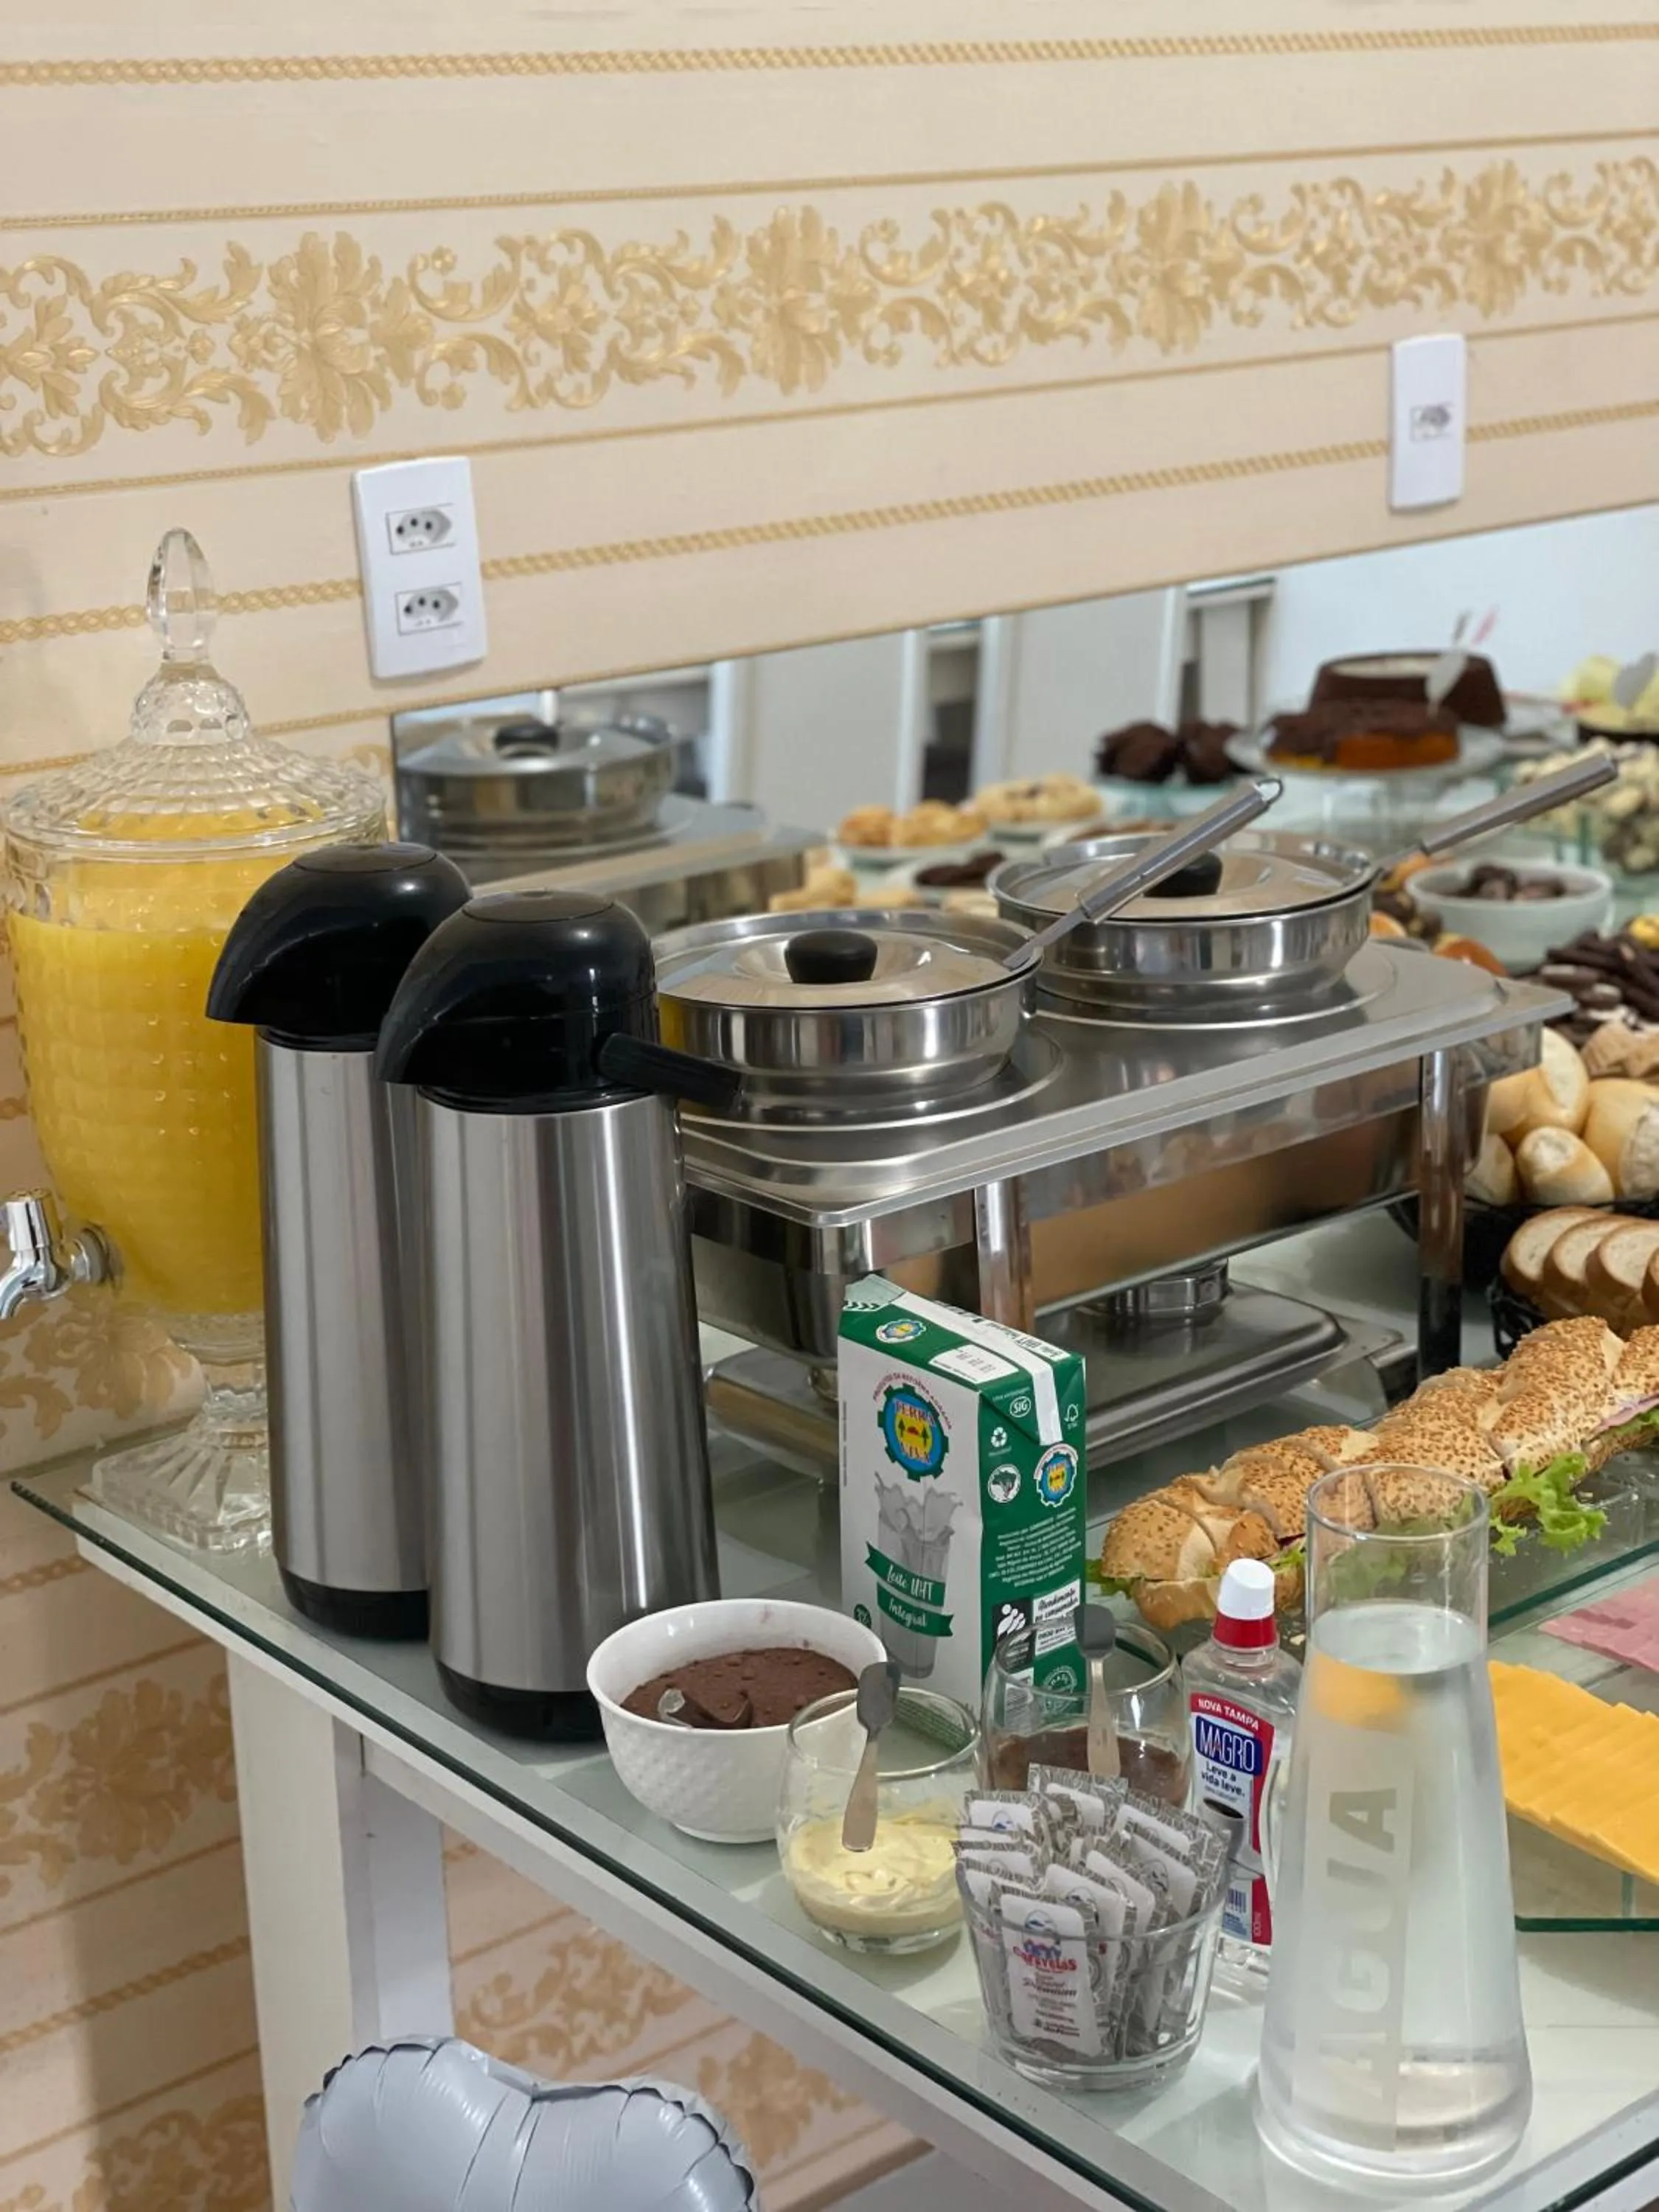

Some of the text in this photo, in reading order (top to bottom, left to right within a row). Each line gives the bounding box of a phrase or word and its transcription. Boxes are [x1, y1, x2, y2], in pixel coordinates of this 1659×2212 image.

[1013, 1400, 1029, 1413] SIG
[911, 1578, 934, 1601] UHT
[1198, 1698, 1259, 1731] NOVA TAMPA
[1200, 1720, 1255, 1772] MAGRO
[1201, 1772, 1220, 1787] vida
[1206, 1761, 1237, 1782] Leve a
